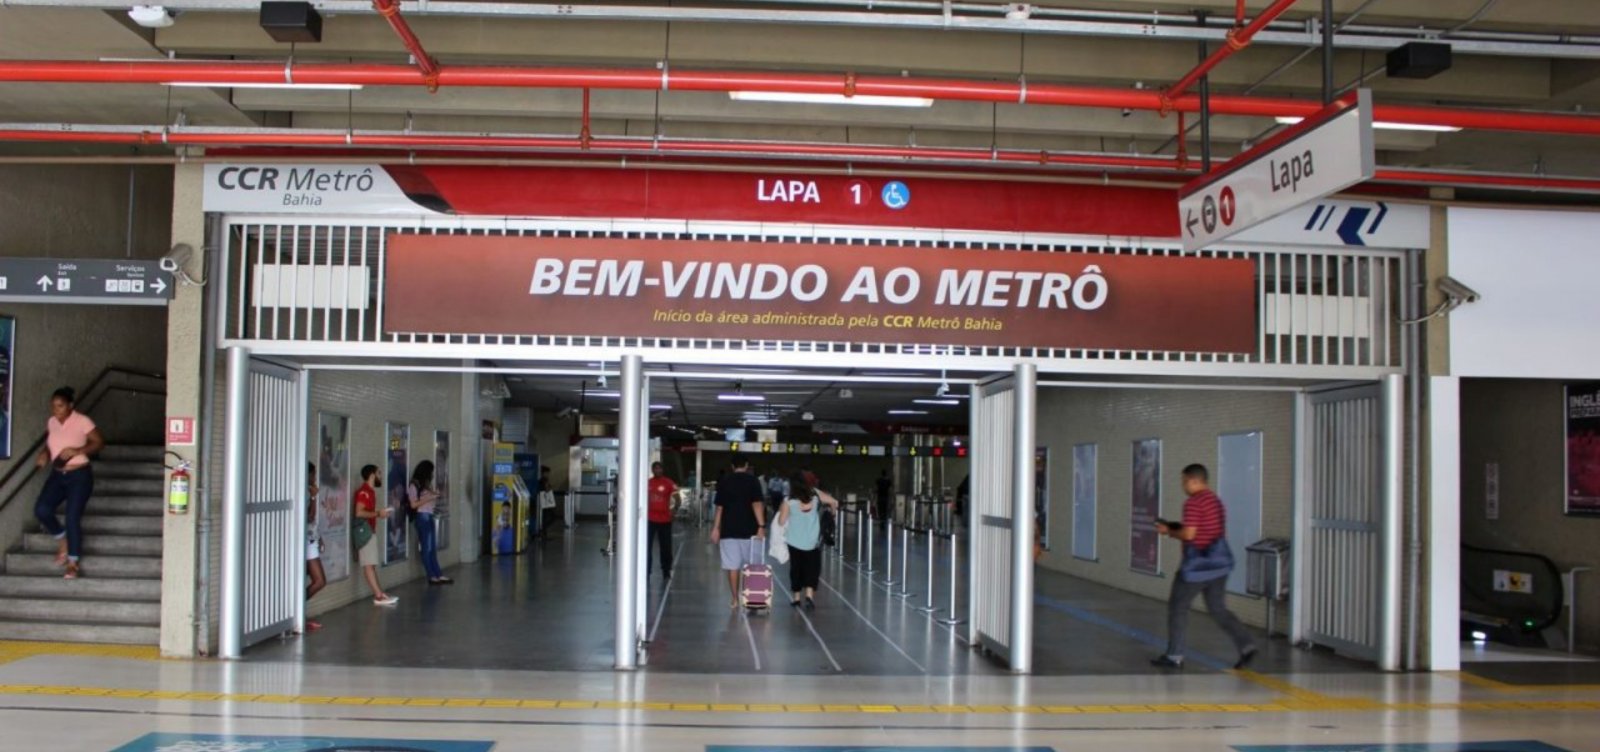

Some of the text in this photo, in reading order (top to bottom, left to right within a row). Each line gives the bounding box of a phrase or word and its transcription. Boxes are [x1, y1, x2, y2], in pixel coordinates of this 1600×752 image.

[218, 166, 374, 192] CCR Metrô
[1269, 149, 1315, 193] Lapa
[282, 193, 322, 206] Bahia
[757, 179, 862, 205] LAPA 1
[116, 264, 145, 272] Serviços
[529, 257, 1109, 310] BEM-VINDO AO METRÔ
[653, 309, 1003, 331] Início da área administrada pela CCR Metrô Bahia
